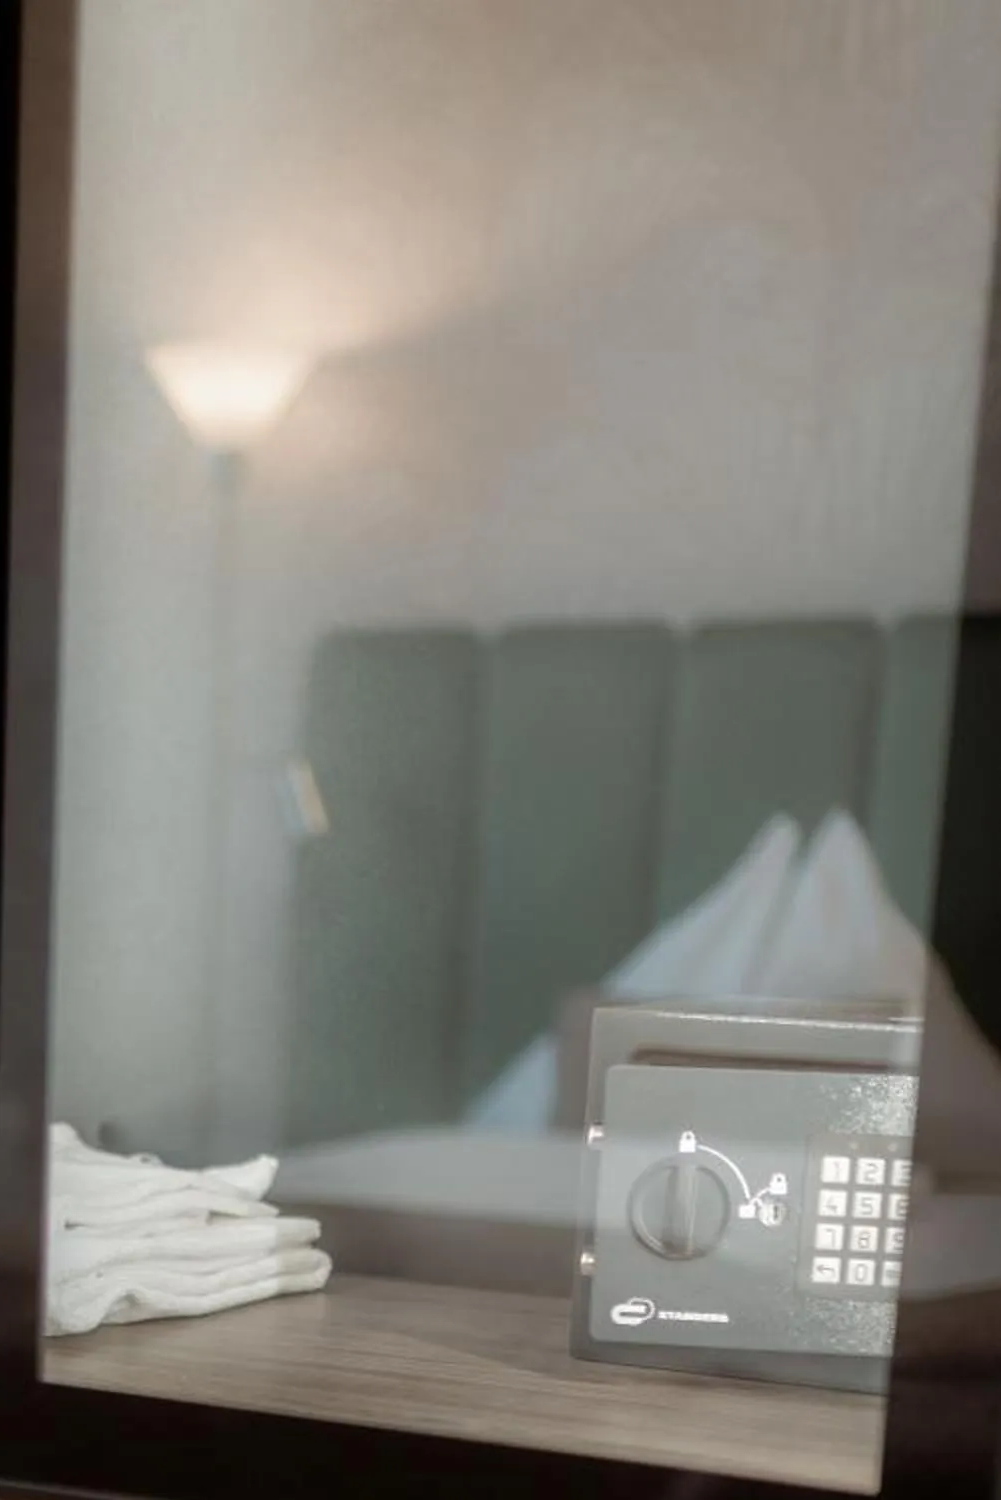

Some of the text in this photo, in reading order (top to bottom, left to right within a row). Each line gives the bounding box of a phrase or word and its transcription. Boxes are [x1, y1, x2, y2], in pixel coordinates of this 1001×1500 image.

[863, 1161, 879, 1183] 2
[858, 1196, 874, 1216] 5
[857, 1230, 871, 1250] 8
[853, 1262, 869, 1283] 0
